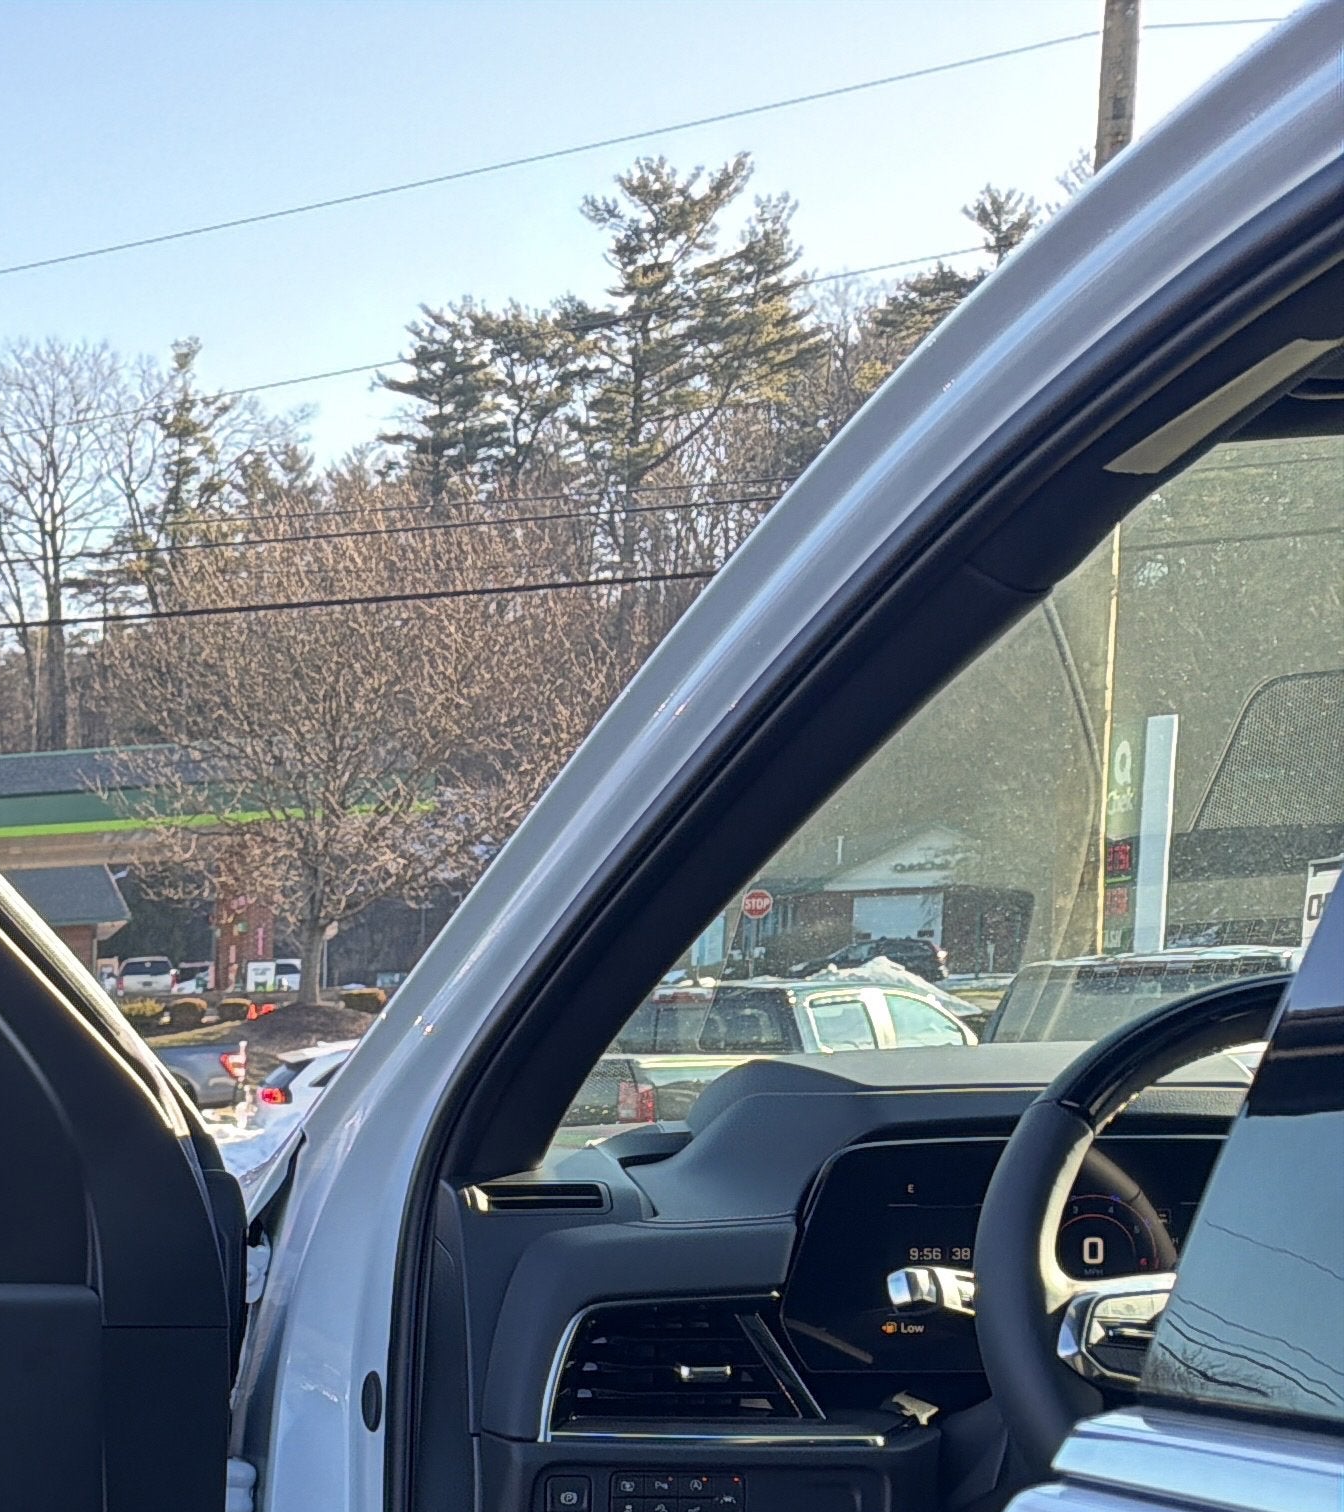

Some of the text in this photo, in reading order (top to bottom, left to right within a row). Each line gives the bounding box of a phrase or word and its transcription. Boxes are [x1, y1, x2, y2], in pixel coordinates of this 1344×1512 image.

[745, 897, 770, 910] STOP
[909, 1248, 971, 1260] 9:56 38
[1083, 1237, 1104, 1265] 0
[901, 1322, 924, 1333] Low
